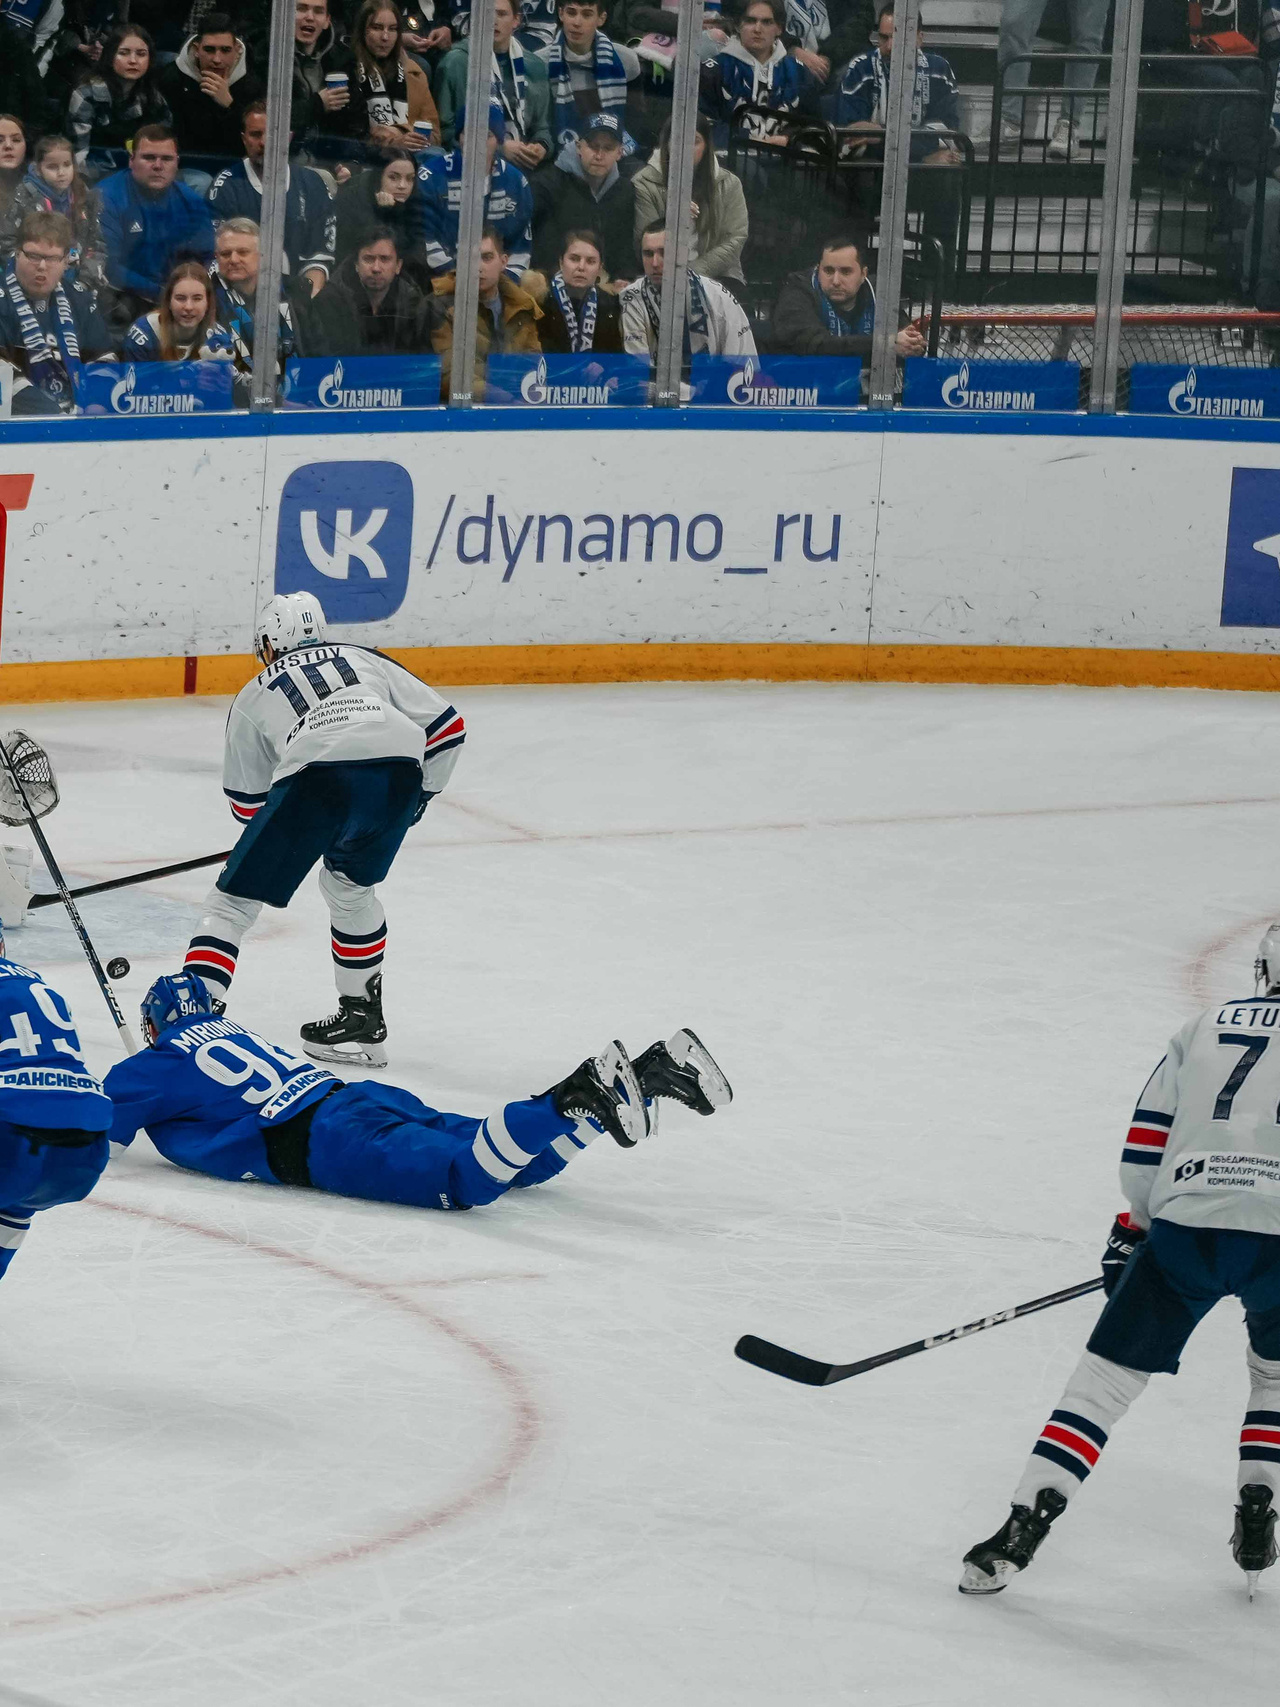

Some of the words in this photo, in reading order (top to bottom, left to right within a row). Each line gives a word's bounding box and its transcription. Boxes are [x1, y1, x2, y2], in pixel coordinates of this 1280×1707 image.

[135, 394, 195, 414] ГАЗПРОМ
[343, 389, 402, 407] ГАЗПРОМ
[546, 386, 609, 405] ГАЗПРОМ
[752, 387, 818, 406] ГАЗПРОМ
[970, 391, 1035, 410] ГАЗПРОМ
[1197, 397, 1264, 417] ГАЗПРОМ
[299, 508, 389, 579] VK
[426, 494, 841, 583] /dynamo_ru
[257, 646, 341, 686] FIRSTOV
[309, 715, 350, 731] КОМПАНИЯ
[180, 1000, 197, 1017] 94
[1216, 1007, 1280, 1028] LETU
[1213, 1033, 1280, 1124] 7
[1209, 1154, 1280, 1169] ОБЪЕДИНЕННАЯ
[1206, 1177, 1255, 1188] КОМПАНИЯ
